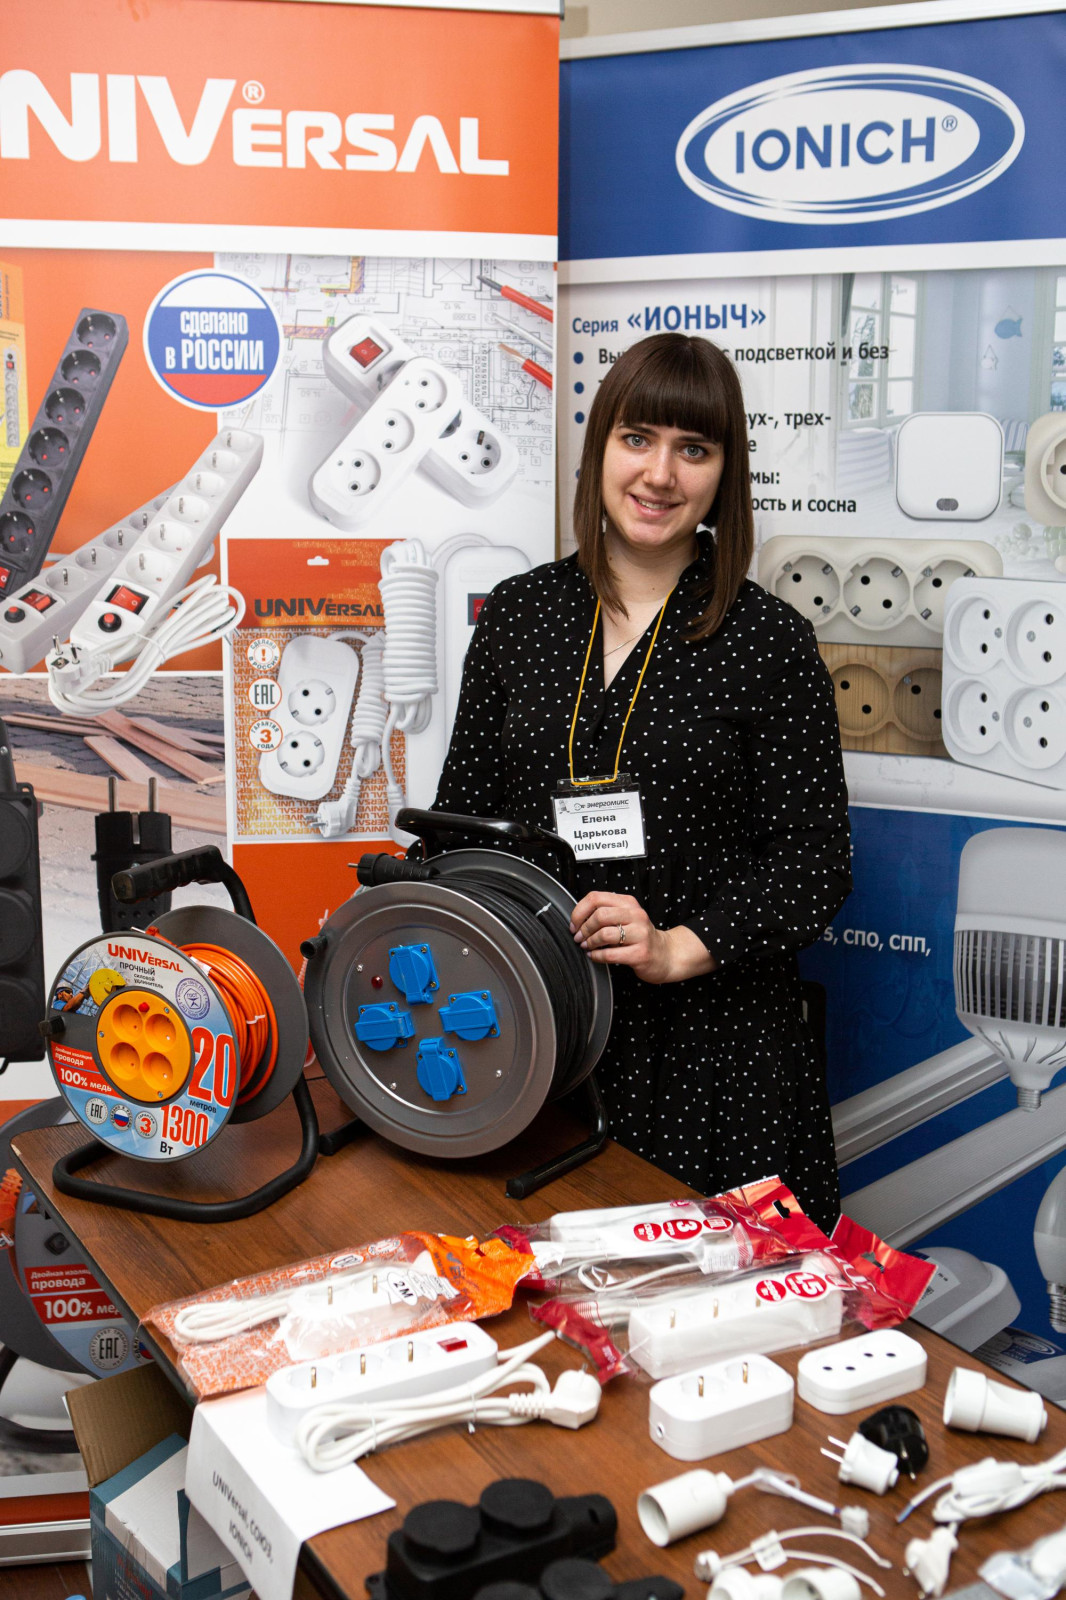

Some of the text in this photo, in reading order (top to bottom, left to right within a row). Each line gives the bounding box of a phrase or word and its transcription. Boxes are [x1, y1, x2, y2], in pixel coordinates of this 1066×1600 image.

[572, 304, 767, 337] Серия «ИОНЫЧ»
[181, 339, 264, 371] РОССИИ
[735, 342, 890, 363] подсветкой и без
[784, 412, 832, 430] трех-
[750, 472, 781, 485] мы:
[751, 498, 857, 513] ость и сосна
[254, 598, 385, 617] UNIVERSAL
[251, 721, 279, 734] ГАРАНТИЯ
[260, 729, 272, 743] 3
[582, 814, 617, 824] Елена
[573, 828, 628, 840] Царькова
[843, 928, 884, 952] СПО,
[889, 934, 932, 957] СПП,
[108, 943, 184, 973] UNIVERSAL
[120, 961, 155, 976] ПРОЧНЫЙ
[55, 1053, 84, 1066] провода
[187, 1026, 237, 1109] 20
[60, 1068, 112, 1093] 100% медь
[189, 1100, 217, 1114] метров
[139, 1117, 152, 1133] 3
[160, 1104, 209, 1149] 1300
[160, 1141, 173, 1155] Вт
[676, 1220, 698, 1233] 3
[31, 1269, 64, 1279] Двойная
[31, 1277, 86, 1291] провода
[44, 1298, 93, 1319] 100%
